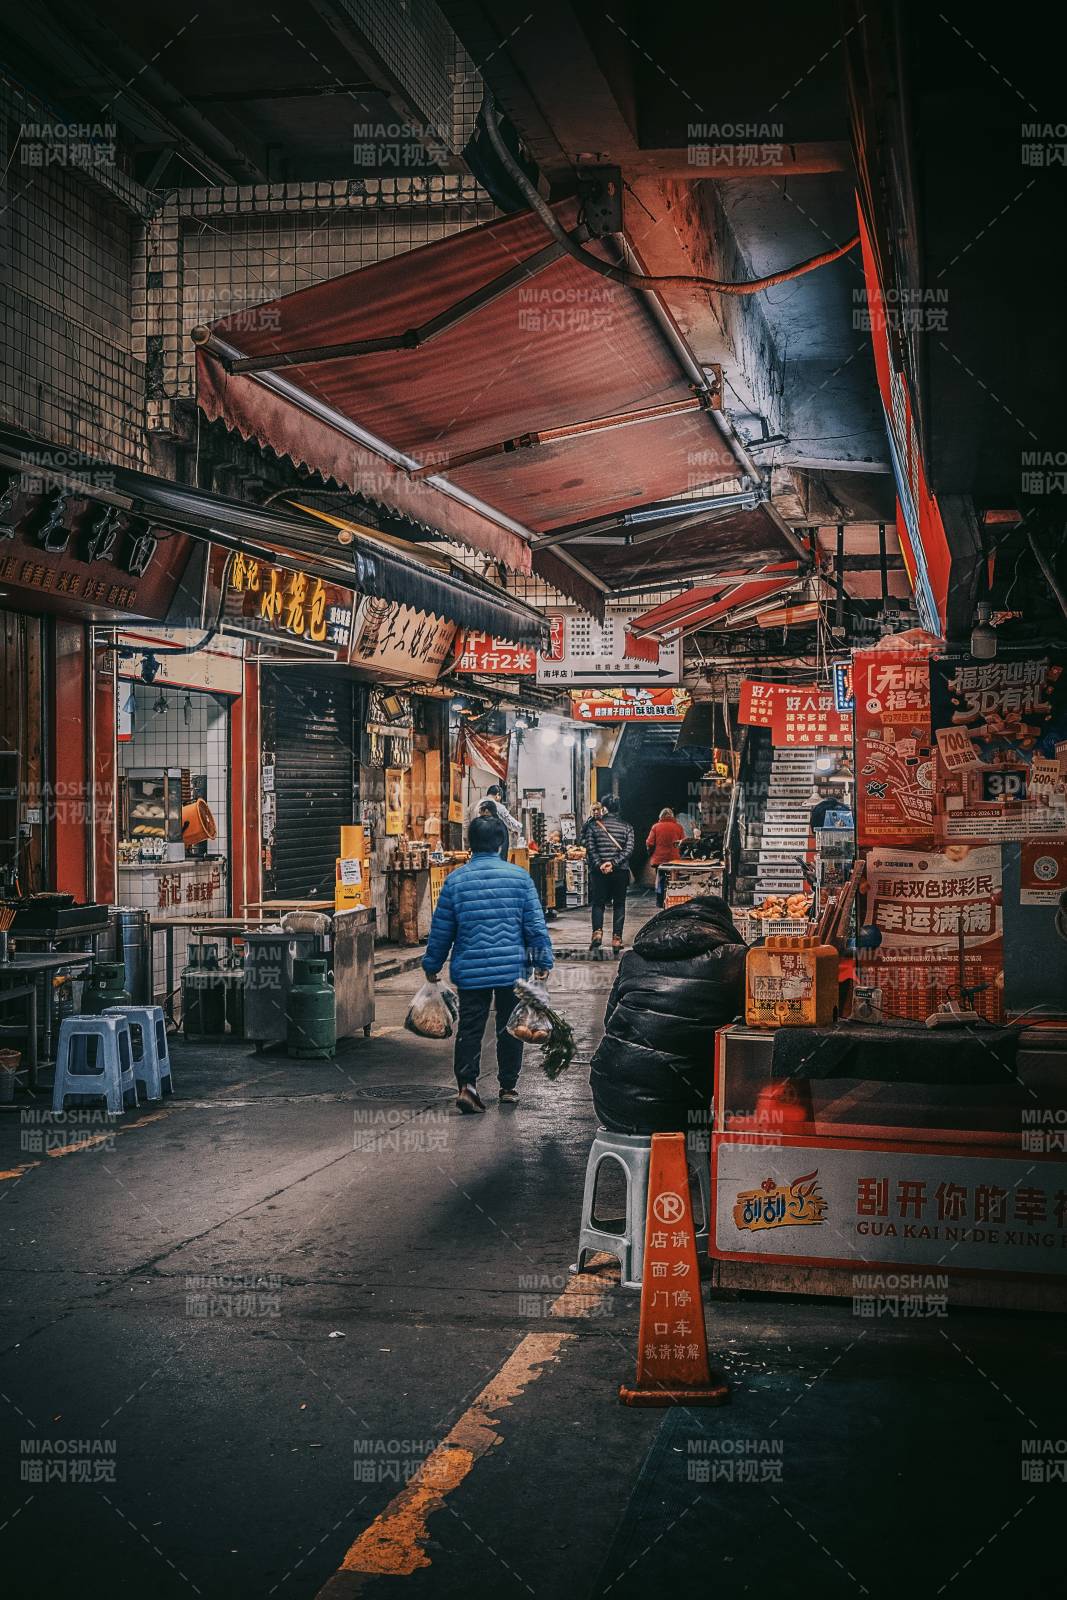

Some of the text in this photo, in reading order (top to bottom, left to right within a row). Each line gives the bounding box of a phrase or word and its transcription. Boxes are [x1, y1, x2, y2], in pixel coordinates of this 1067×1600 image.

[261, 569, 328, 642] 小笼包
[461, 653, 532, 670] 前行2米
[948, 657, 1051, 694] 福彩迎新
[875, 664, 931, 694] 无限
[953, 684, 1052, 724] 3D有礼
[988, 775, 1020, 794] 3D
[877, 875, 993, 899] 重庆双色球彩民
[876, 903, 992, 935] 幸运满满
[857, 1221, 898, 1238] GUA
[904, 1224, 939, 1240] KAI
[945, 1227, 967, 1242] NI
[972, 1229, 999, 1244] DE
[1004, 1231, 1056, 1248] XING
[644, 1342, 701, 1362] 敬请谅解
